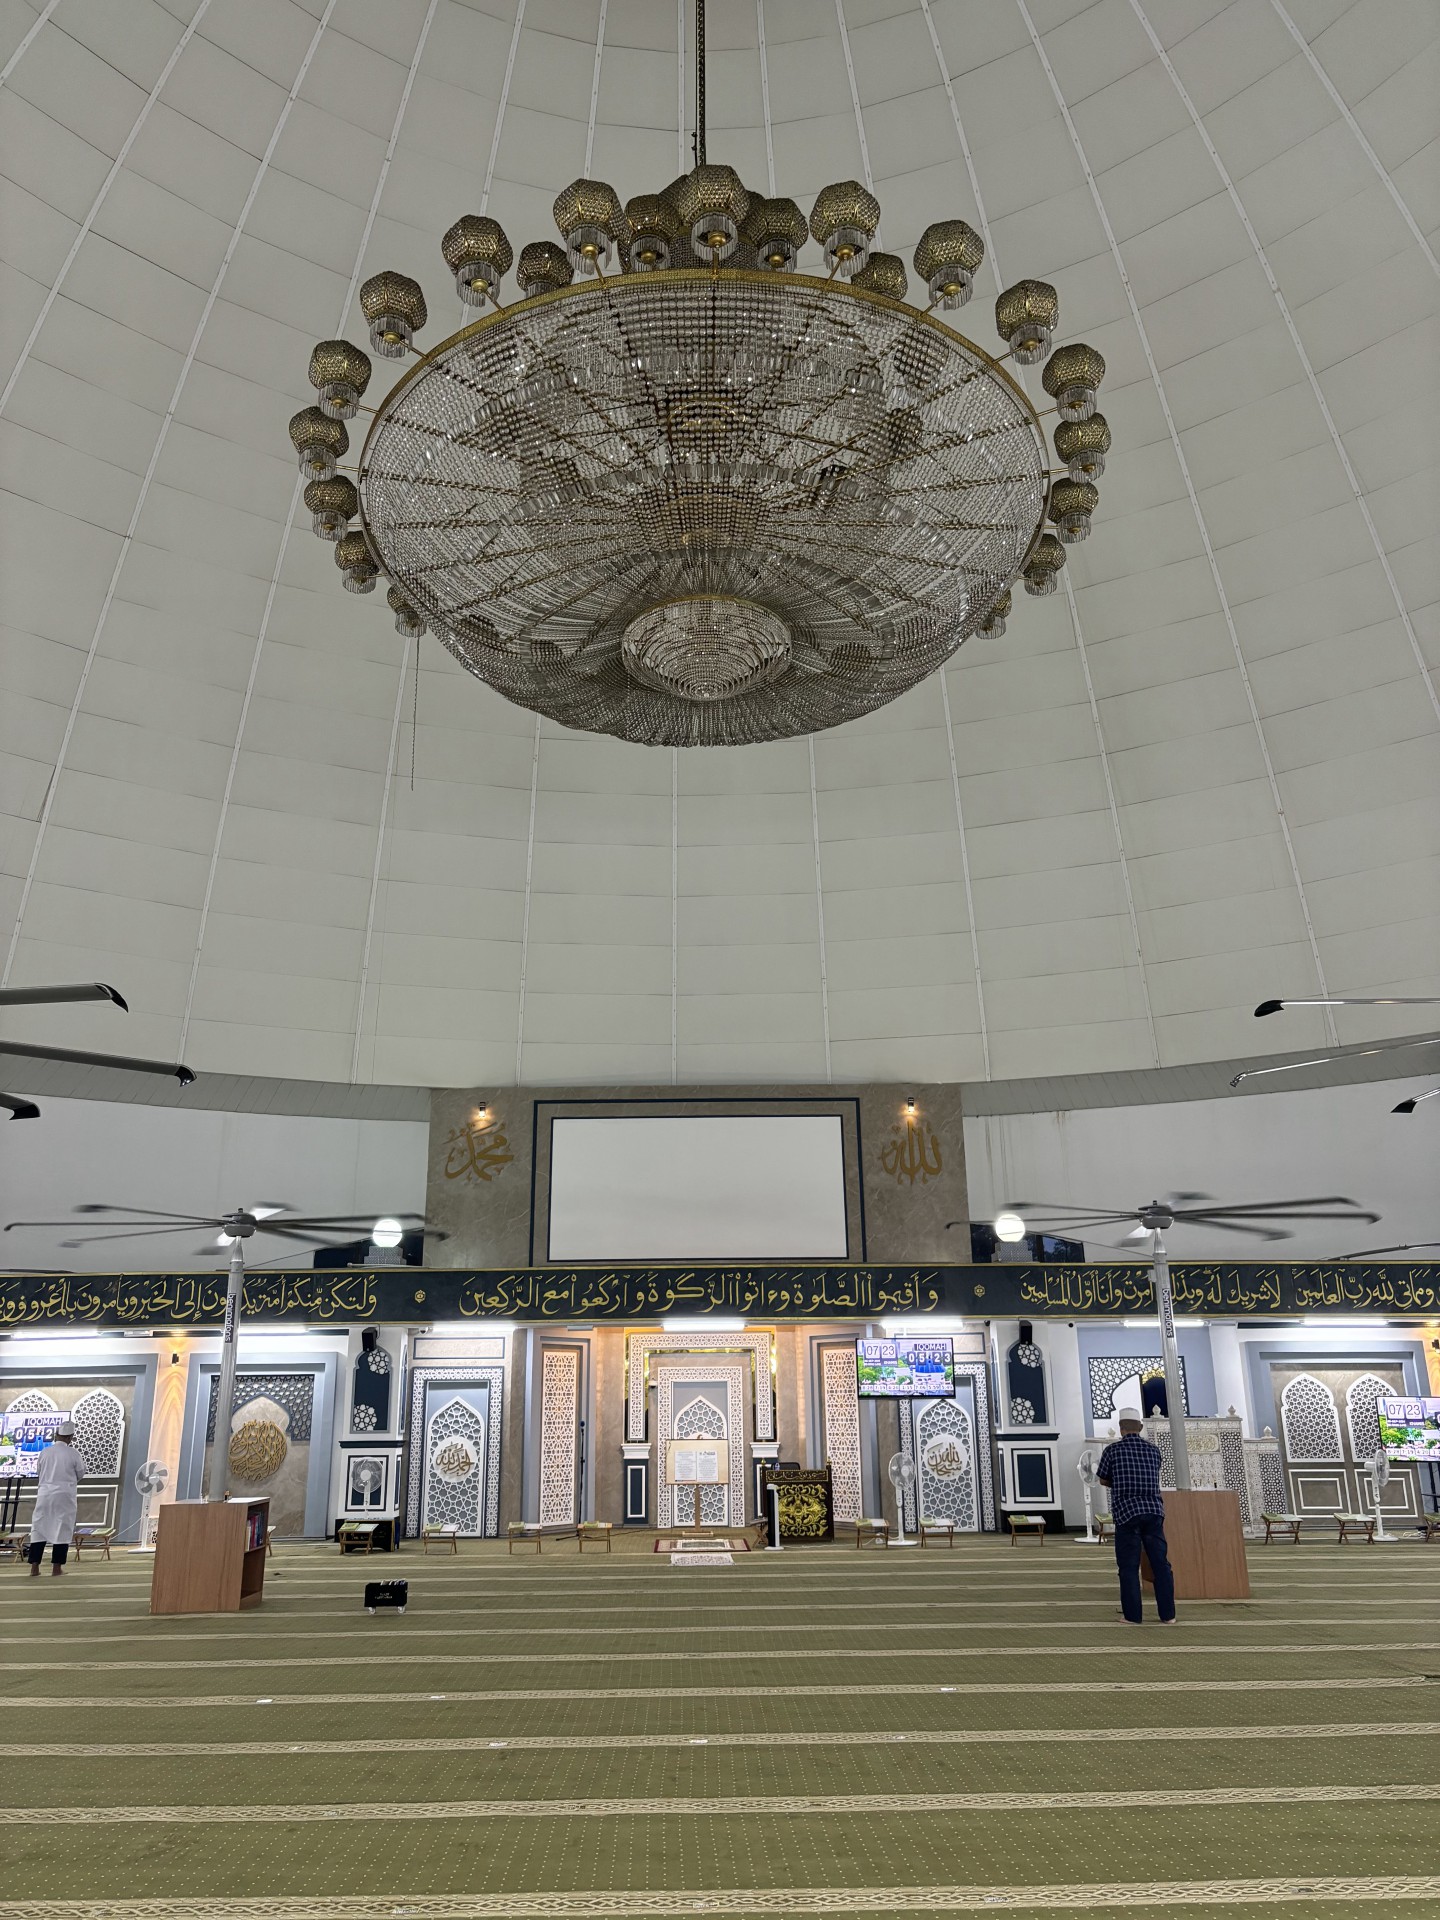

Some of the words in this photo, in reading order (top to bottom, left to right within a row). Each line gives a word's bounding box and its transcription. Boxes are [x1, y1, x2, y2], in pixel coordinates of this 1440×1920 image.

[866, 1345, 879, 1356] 07
[882, 1345, 895, 1356] 23
[1388, 1404, 1402, 1415] 07
[1406, 1404, 1420, 1415] 23
